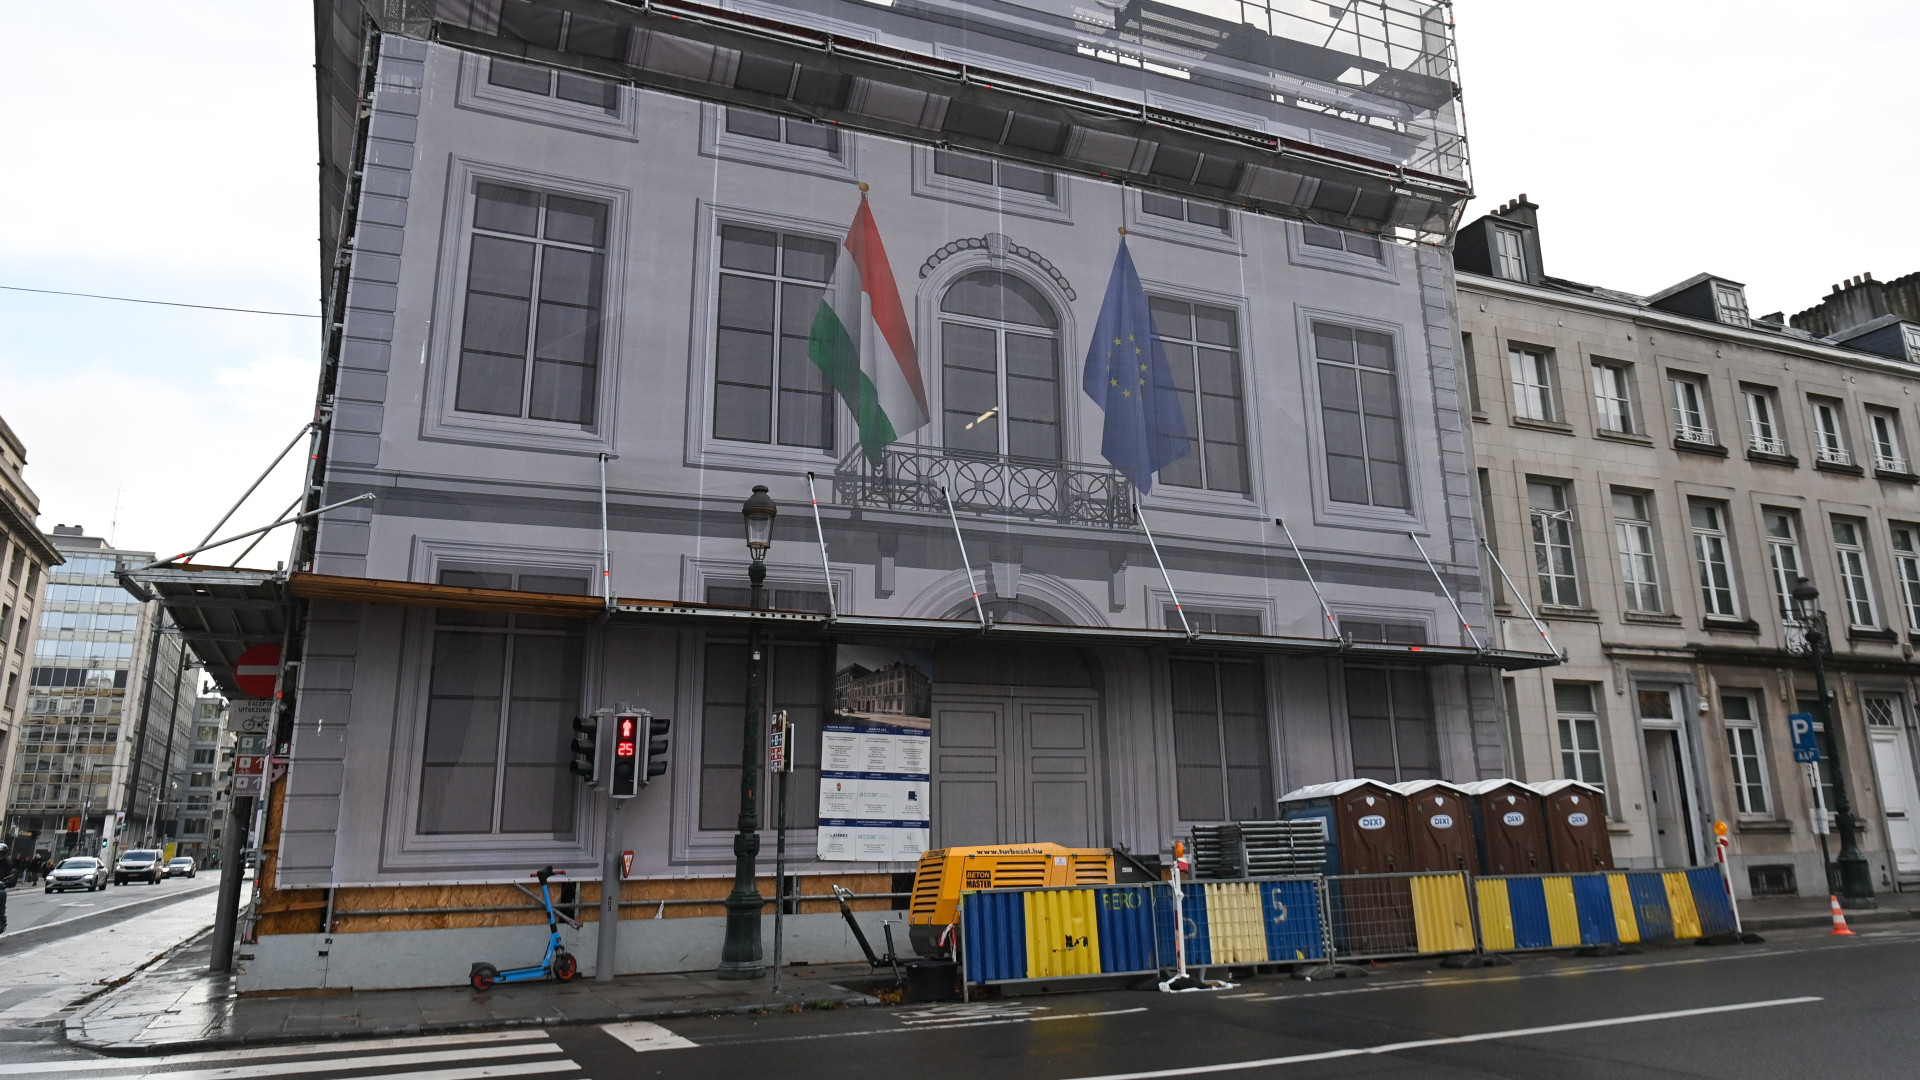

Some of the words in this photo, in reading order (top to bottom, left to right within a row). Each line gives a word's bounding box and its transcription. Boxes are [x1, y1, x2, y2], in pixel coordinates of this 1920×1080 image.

[1792, 719, 1809, 745] P
[618, 743, 633, 756] 25
[1362, 818, 1383, 827] DIXI
[1507, 815, 1522, 823] DIXI
[1571, 816, 1586, 824] DIXI
[976, 848, 1043, 856] www.turbosol.hu
[966, 871, 990, 879] BETON
[966, 880, 992, 889] MASTER
